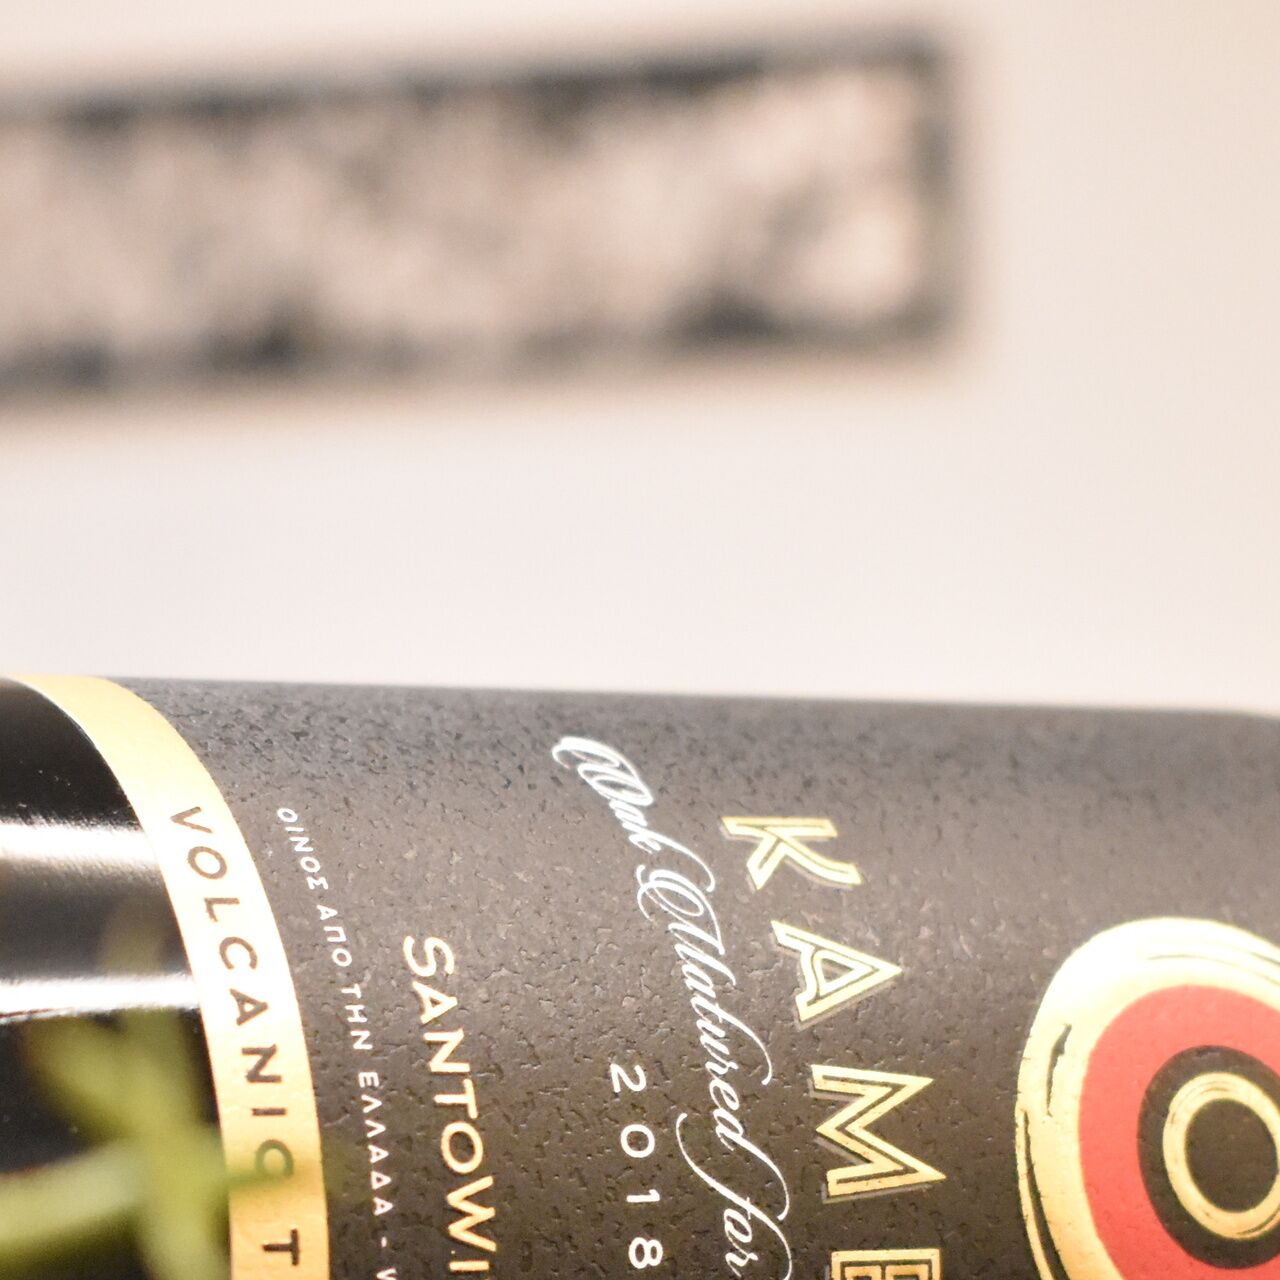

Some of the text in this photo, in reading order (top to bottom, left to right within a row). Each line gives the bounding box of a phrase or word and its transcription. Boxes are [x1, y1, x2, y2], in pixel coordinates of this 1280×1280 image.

[276, 806, 329, 891] ΟΙΝΟΣ
[316, 903, 353, 968] ΑΠΟ
[340, 982, 373, 1052] ΤΗΝ
[357, 1071, 394, 1217] ΕΛΛΑΔΑ
[551, 735, 716, 893] Oak
[636, 864, 790, 1222] Matured
[609, 1062, 664, 1270] 2018
